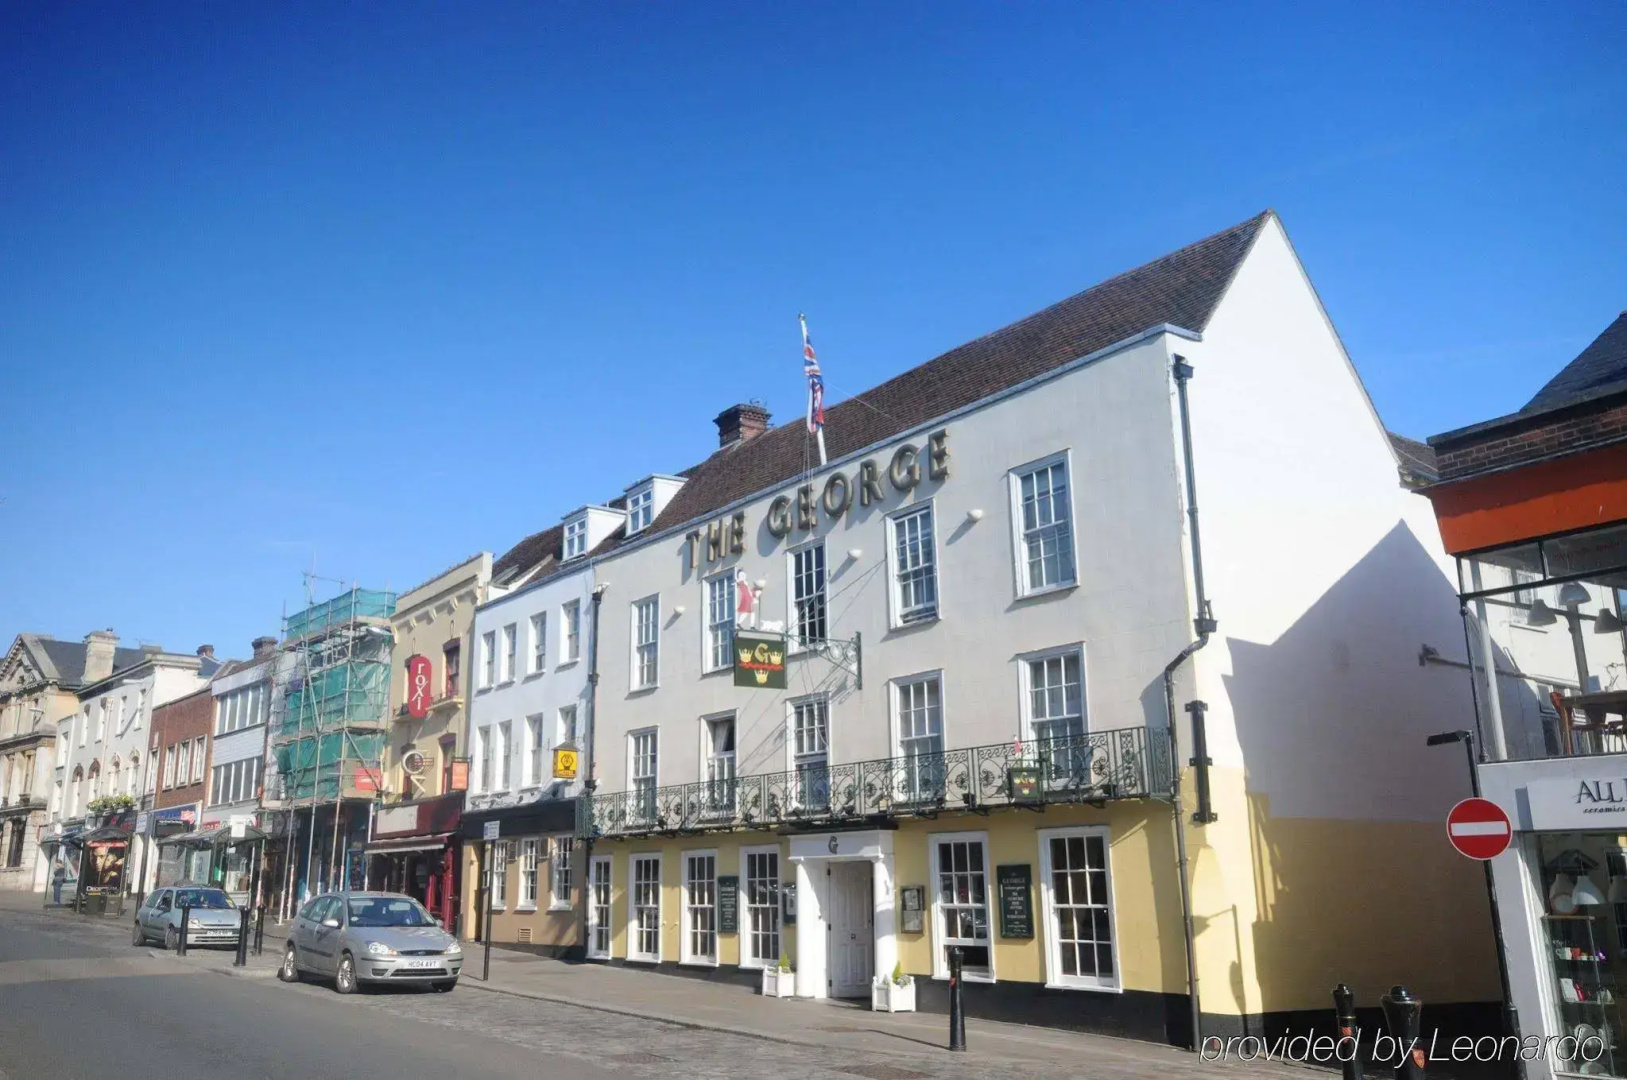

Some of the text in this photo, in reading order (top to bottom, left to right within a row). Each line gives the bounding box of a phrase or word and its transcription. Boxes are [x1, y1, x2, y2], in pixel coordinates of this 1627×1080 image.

[685, 428, 951, 569] THE GEORGE
[754, 642, 769, 664] G
